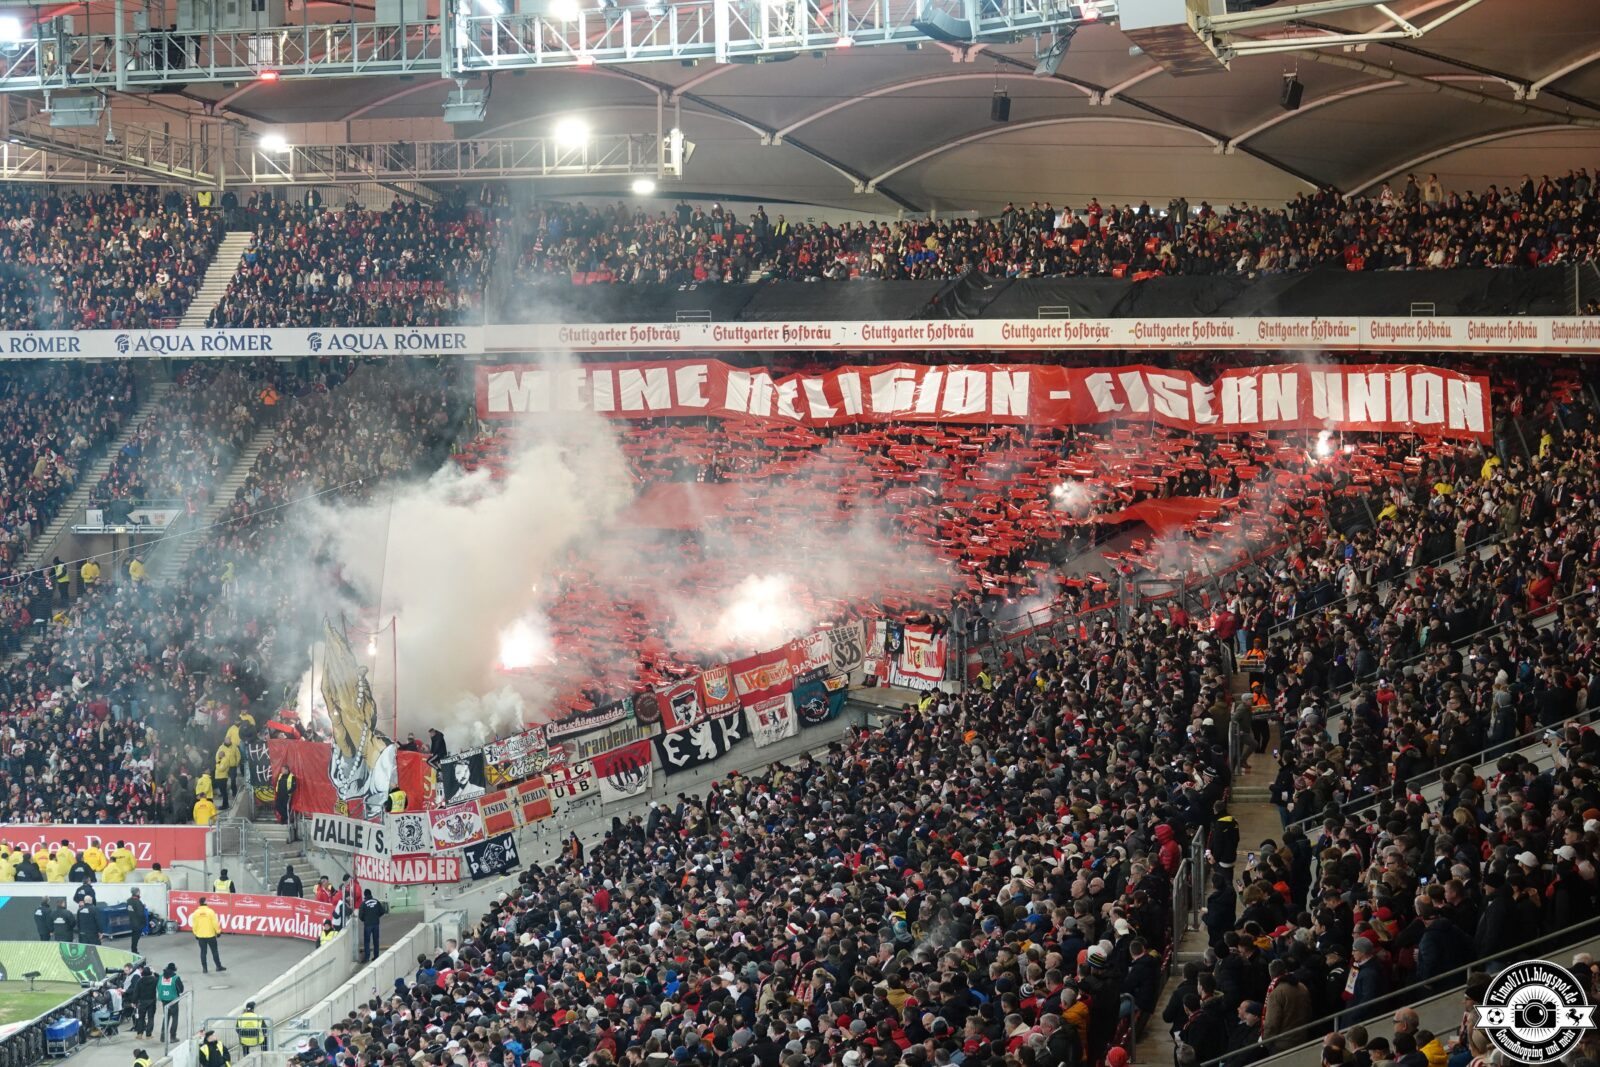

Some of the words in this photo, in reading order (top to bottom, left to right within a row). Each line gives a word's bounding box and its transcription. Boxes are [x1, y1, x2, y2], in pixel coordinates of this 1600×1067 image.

[327, 333, 388, 353] AQUA
[396, 328, 467, 350] RÖMER
[559, 326, 627, 344] Stuttgarter
[630, 325, 680, 343] Hofbräu
[713, 325, 778, 343] Stuttgarter
[783, 324, 831, 342] Hofbräu
[862, 324, 924, 343] Stuttgarter
[927, 323, 974, 343] Hofbräu
[1002, 323, 1061, 342] Stuttgarter
[1064, 322, 1110, 342] Hofbräu
[1135, 322, 1190, 341] Stuttgarter
[1192, 321, 1234, 342] Hofbräu
[1311, 320, 1350, 341] Hofbräu
[1371, 320, 1415, 342] Stuttgarter
[1417, 320, 1451, 341] Hofbräu
[1468, 320, 1506, 343] Stuttgarter
[1508, 320, 1537, 343] Hofbräu
[10, 333, 81, 353] RÖMER
[135, 335, 195, 355] AQUA
[201, 330, 273, 352] RÖMER
[488, 365, 708, 412] MEINE
[726, 369, 1031, 418] RELIGION
[1085, 370, 1299, 424] EISERN
[1311, 370, 1485, 433] UNION
[791, 634, 822, 651] GARDE
[704, 666, 728, 682] UNION
[483, 802, 510, 817] EISERN
[522, 787, 548, 804] BERLIN
[313, 818, 363, 848] HALLE
[375, 830, 388, 855] S.
[355, 855, 457, 882] SACHSENADLER
